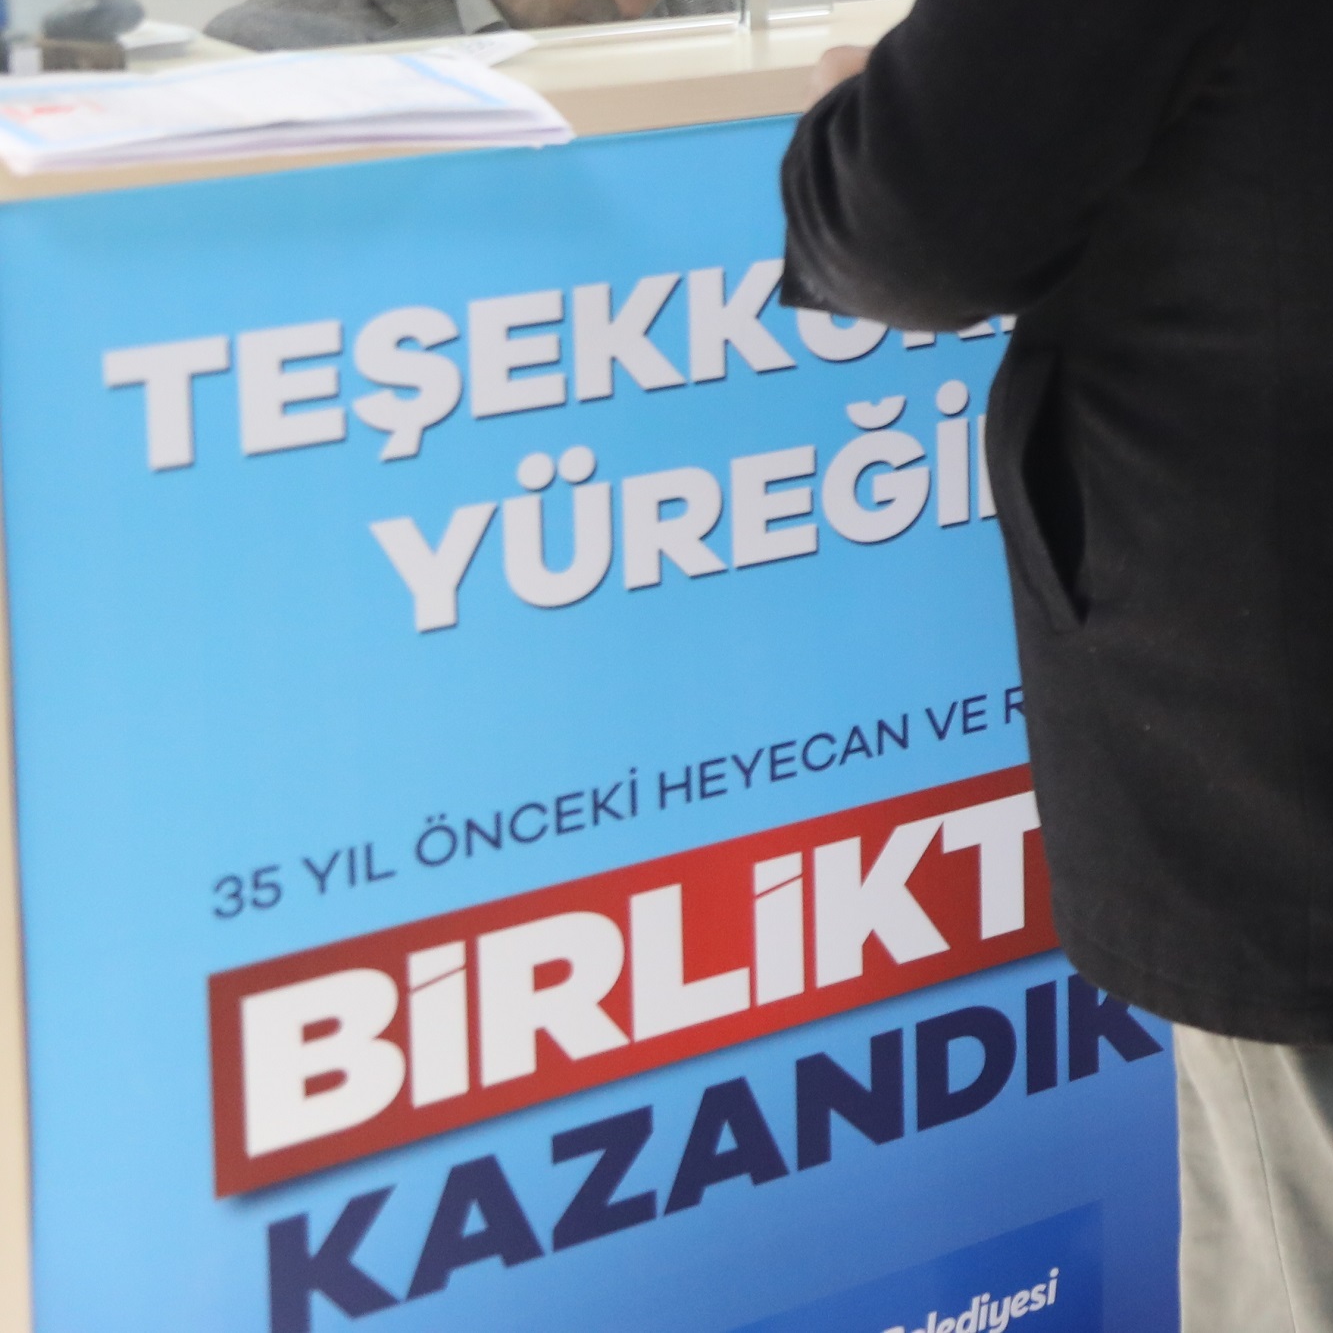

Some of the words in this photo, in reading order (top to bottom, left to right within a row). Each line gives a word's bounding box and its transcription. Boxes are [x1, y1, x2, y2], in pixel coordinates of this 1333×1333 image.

[368, 379, 997, 634] YÜREĞİ
[213, 865, 283, 920] 35
[302, 841, 398, 896] YIL
[413, 767, 640, 869] ÖNCEKİ
[657, 712, 910, 811] HEYECAN
[924, 693, 988, 743] VE
[240, 789, 1042, 1161] BİRLİKT
